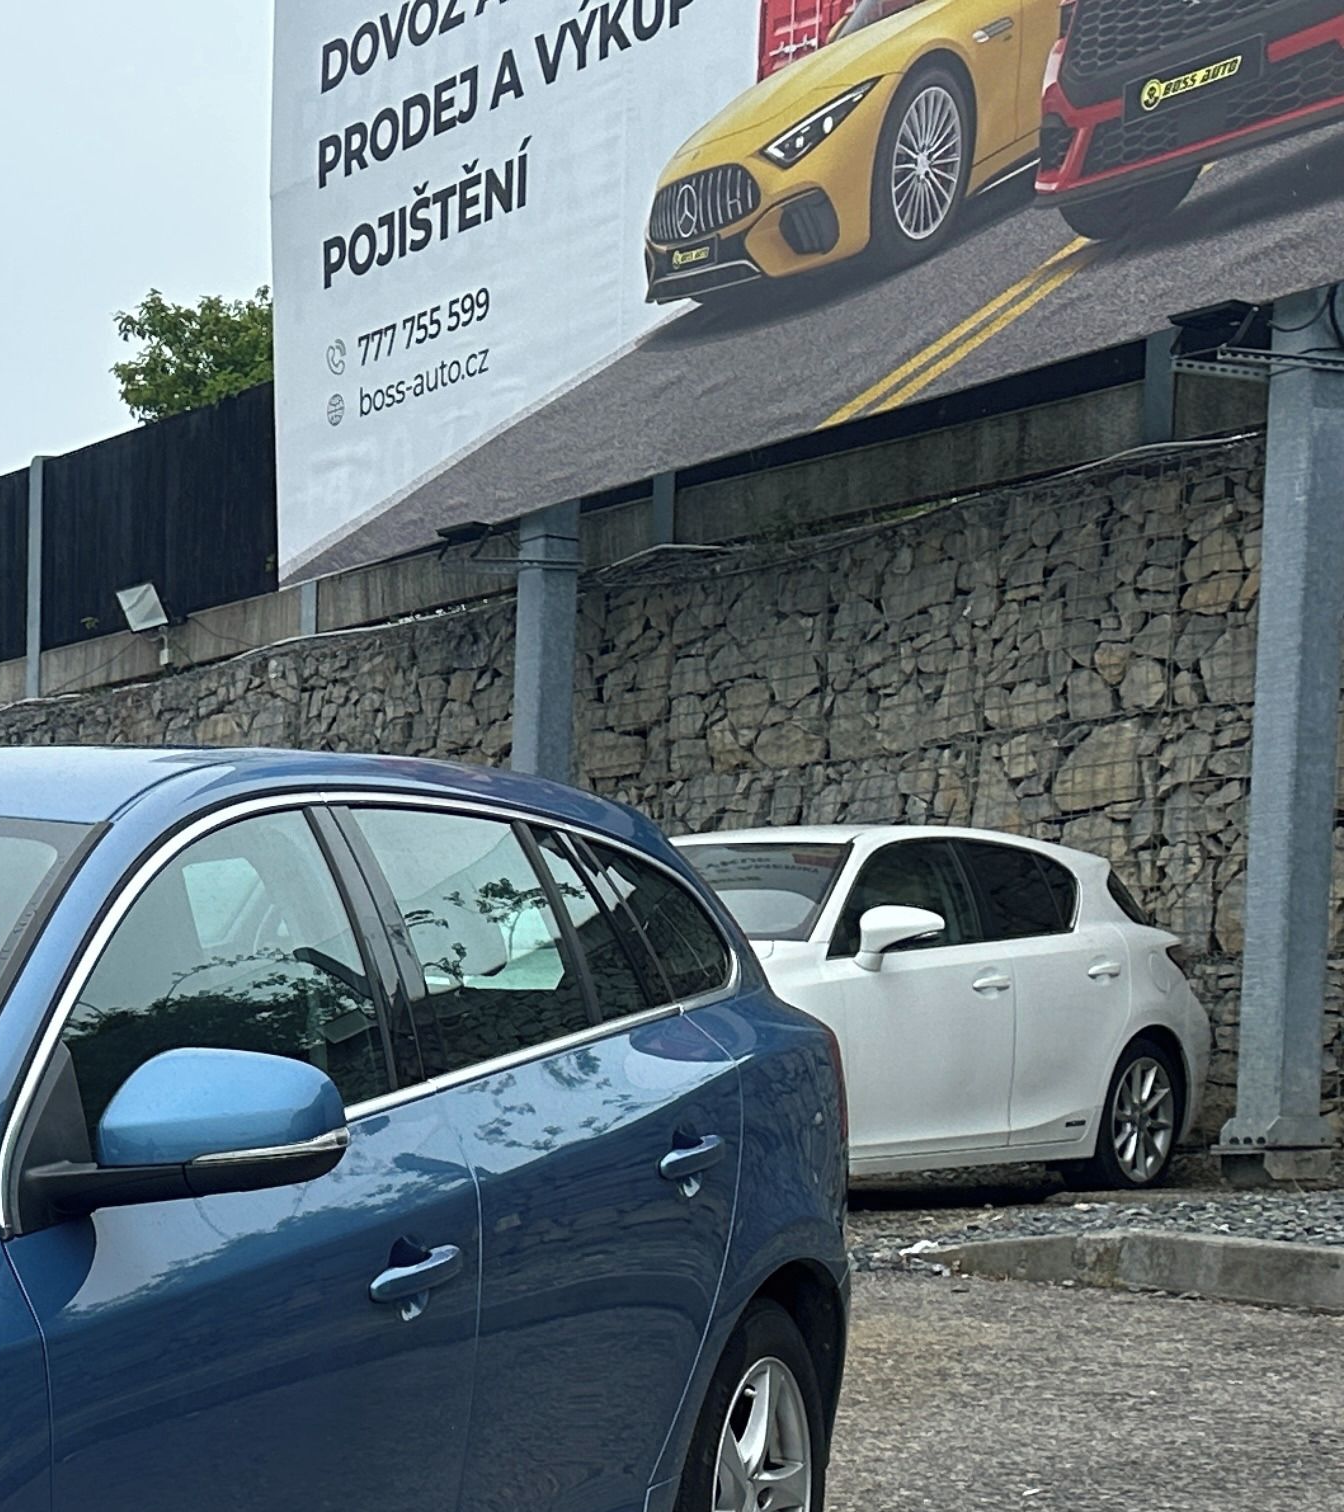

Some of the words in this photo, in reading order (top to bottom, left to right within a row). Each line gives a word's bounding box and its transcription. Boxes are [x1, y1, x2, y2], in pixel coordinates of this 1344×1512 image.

[321, 0, 465, 94] DOVOZ
[1162, 73, 1198, 97] BOSS
[1200, 58, 1239, 83] AUTO
[318, 64, 480, 189] PRODEJ
[489, 48, 525, 111] A
[322, 135, 533, 289] POJIŠTĚNÍ
[357, 323, 397, 366] 777
[402, 305, 441, 350] 755
[447, 287, 490, 332] 599
[359, 348, 489, 418] boss-auto.cz
